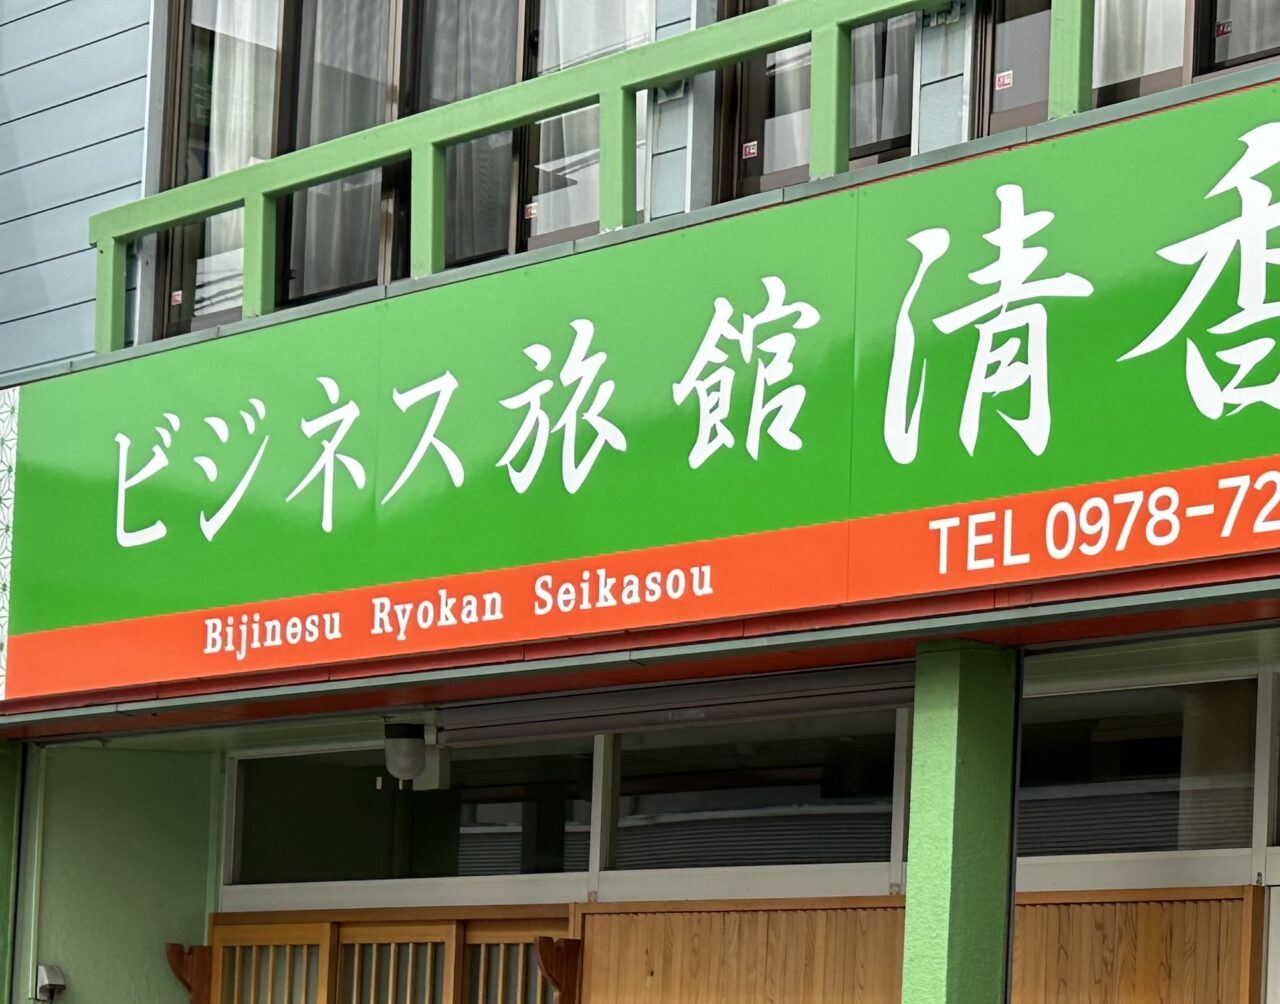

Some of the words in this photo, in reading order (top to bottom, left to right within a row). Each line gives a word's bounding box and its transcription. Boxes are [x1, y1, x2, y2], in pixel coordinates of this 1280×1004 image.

[115, 276, 820, 547] ビジネス旅館
[928, 516, 1030, 575] TEL
[203, 609, 342, 660] Bijinesu
[370, 587, 504, 641] Ryokan
[533, 560, 714, 613] Seikasou
